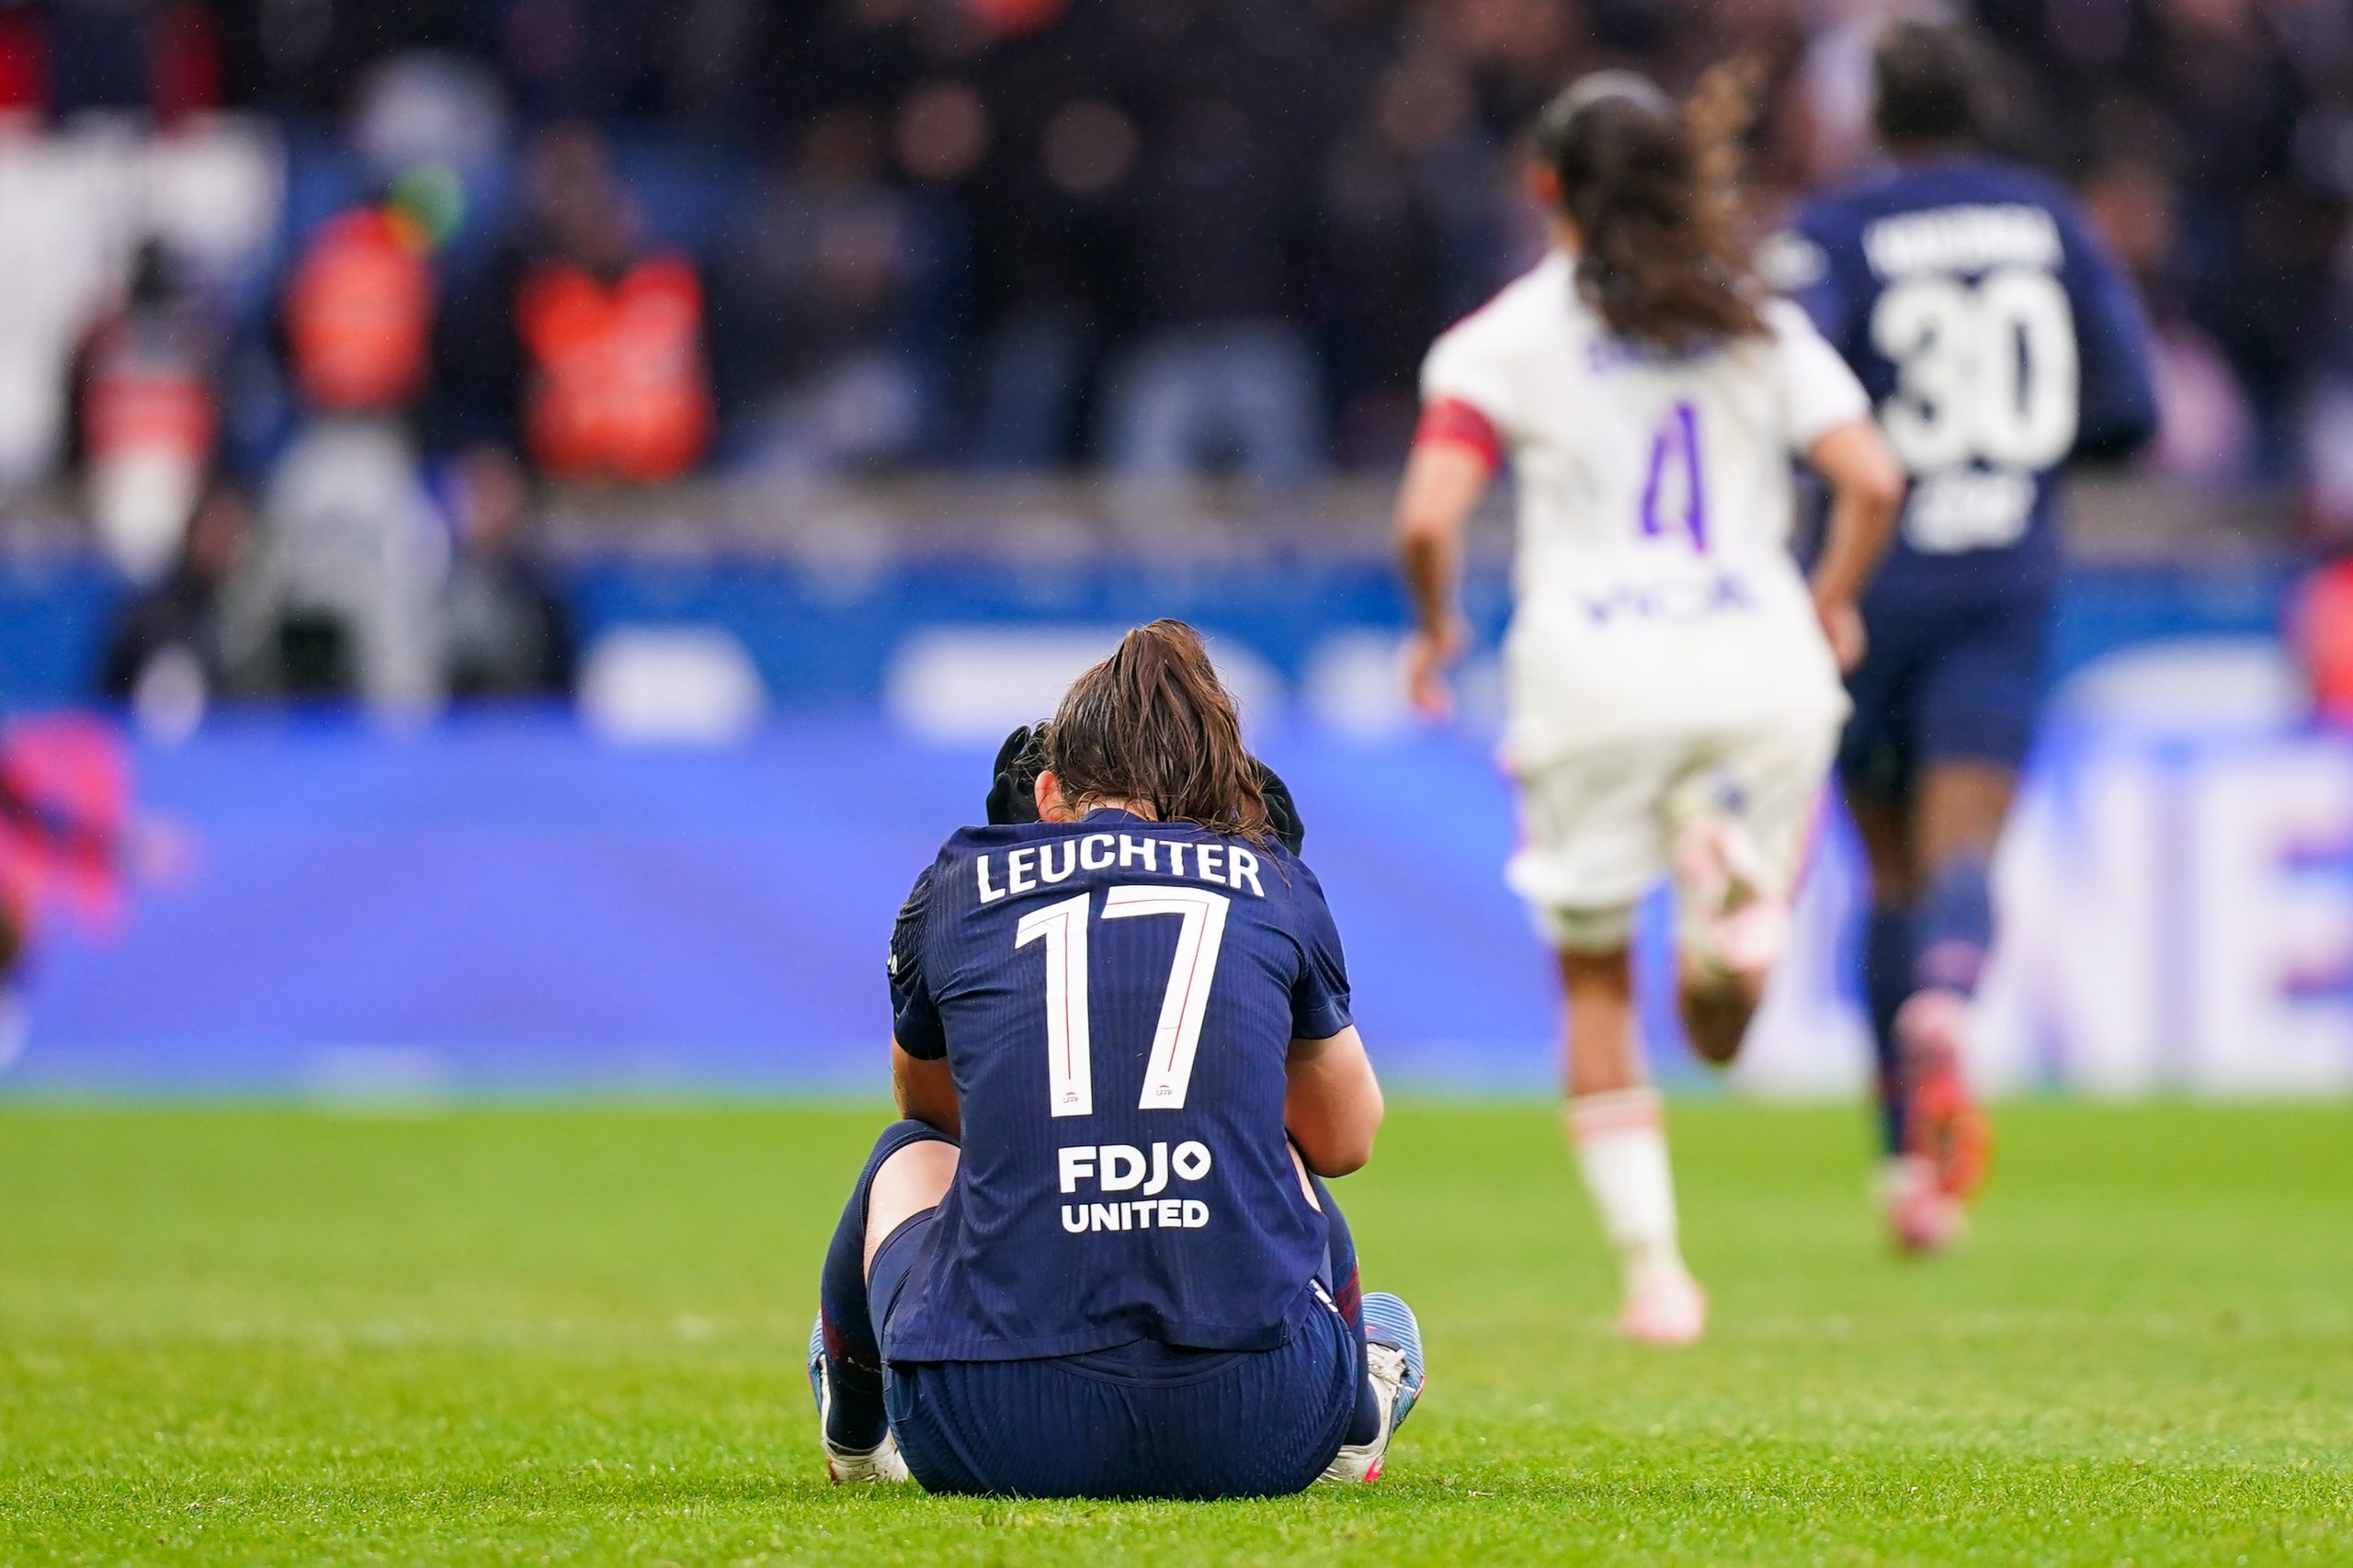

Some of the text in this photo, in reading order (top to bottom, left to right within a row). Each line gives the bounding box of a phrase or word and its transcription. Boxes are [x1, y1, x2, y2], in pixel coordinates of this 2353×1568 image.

[1871, 278, 2079, 471] 30
[1640, 401, 1706, 551] 4
[975, 833, 1266, 904] LEUCHTER
[1014, 883, 1232, 1118] 17
[1061, 1199, 1210, 1233] UNITED
